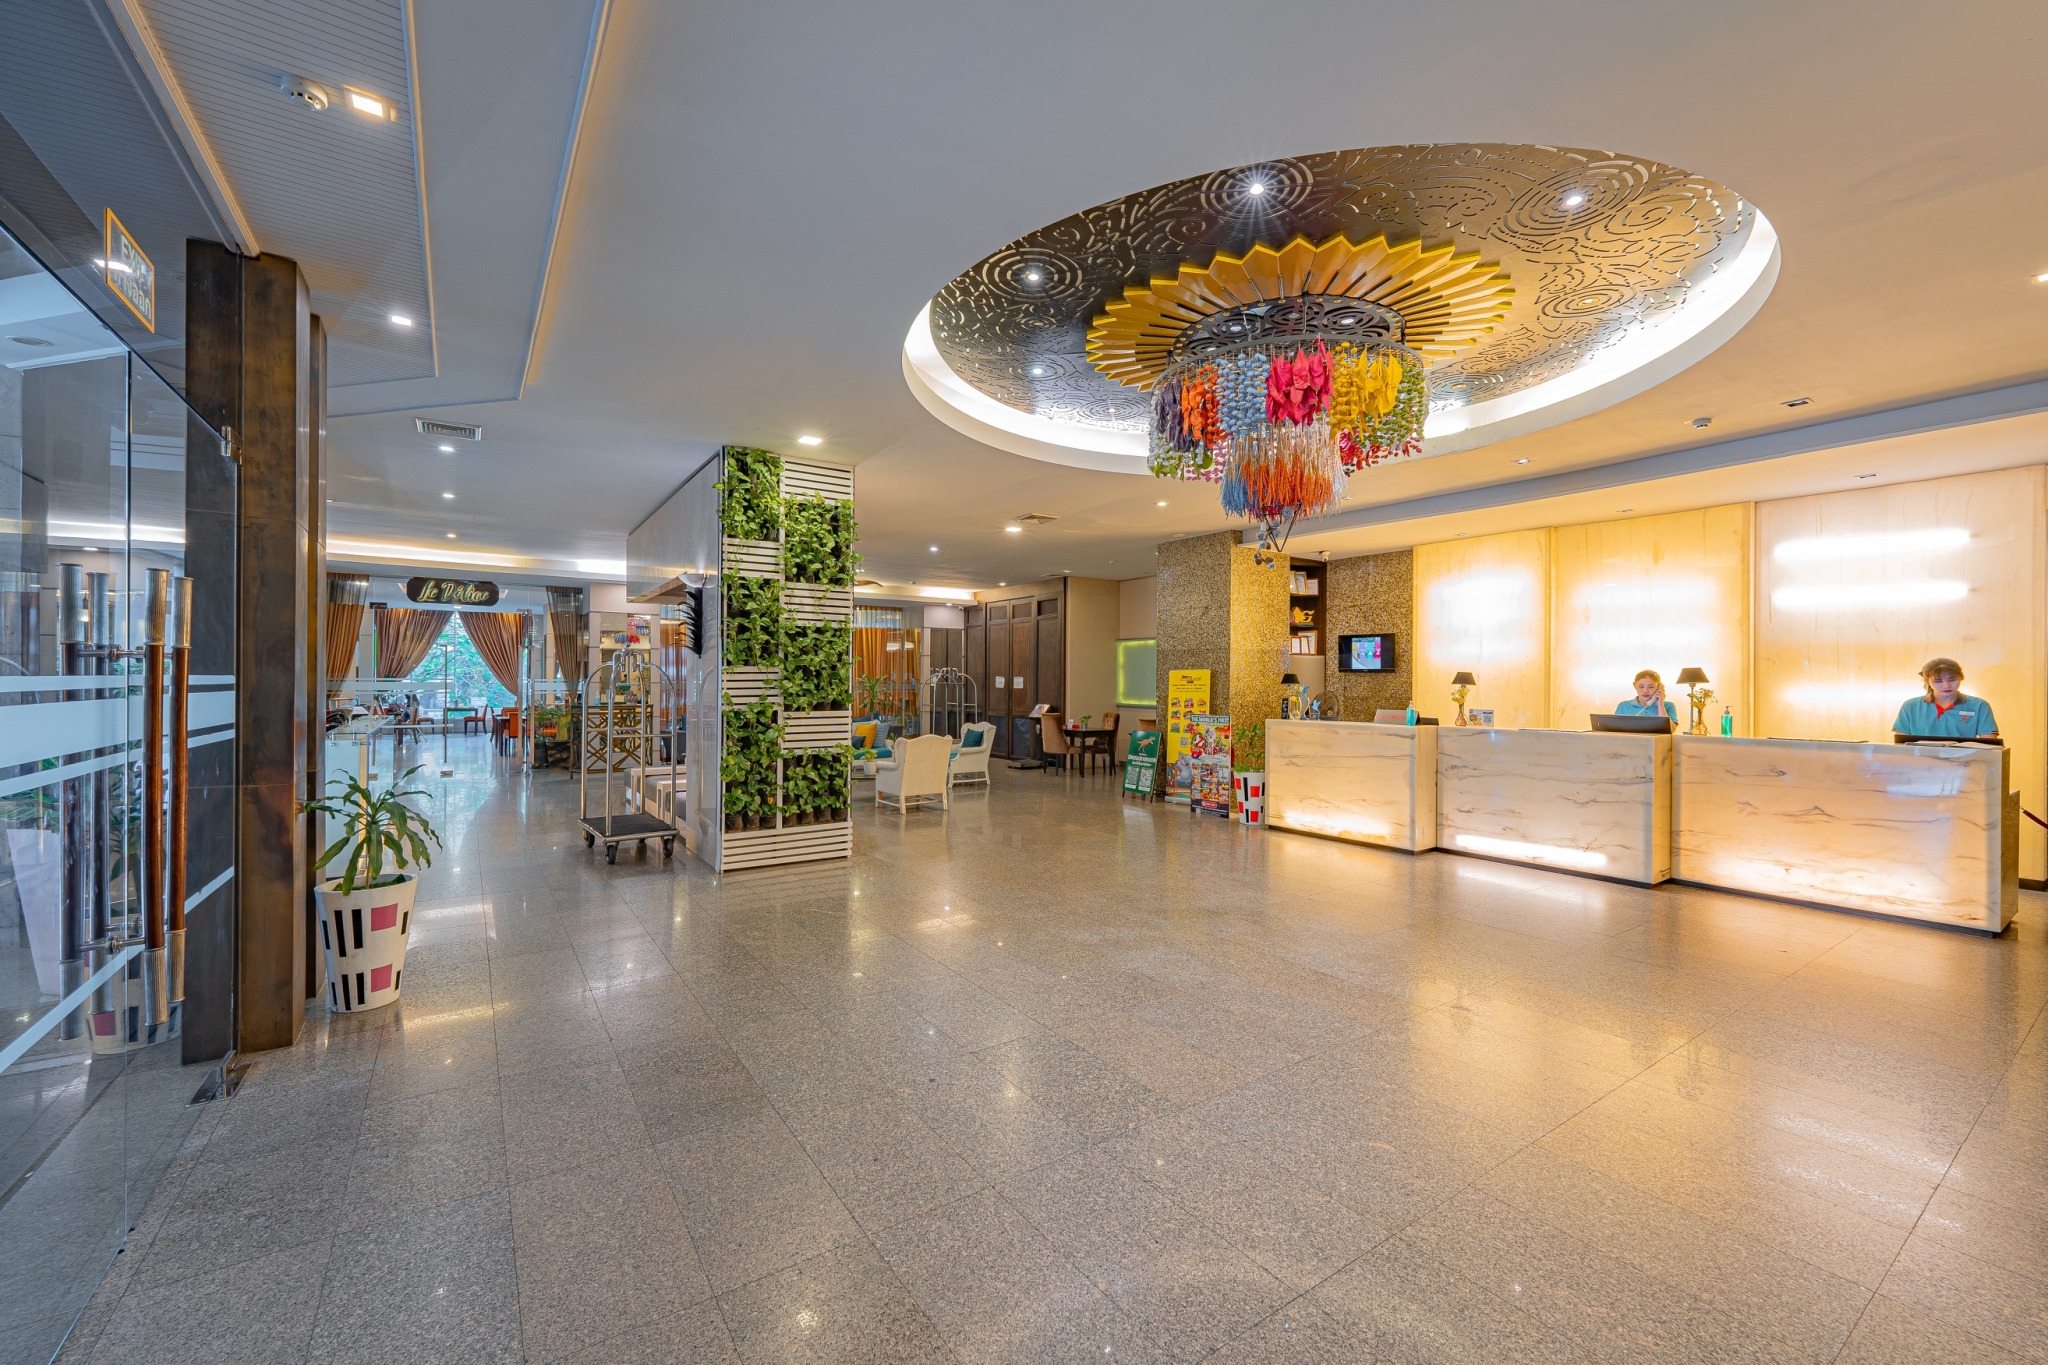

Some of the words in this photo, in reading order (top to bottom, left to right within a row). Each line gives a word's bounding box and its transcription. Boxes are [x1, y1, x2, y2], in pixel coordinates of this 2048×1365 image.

[121, 235, 144, 280] EXIT
[417, 580, 439, 602] Le
[441, 581, 490, 602] Délice
